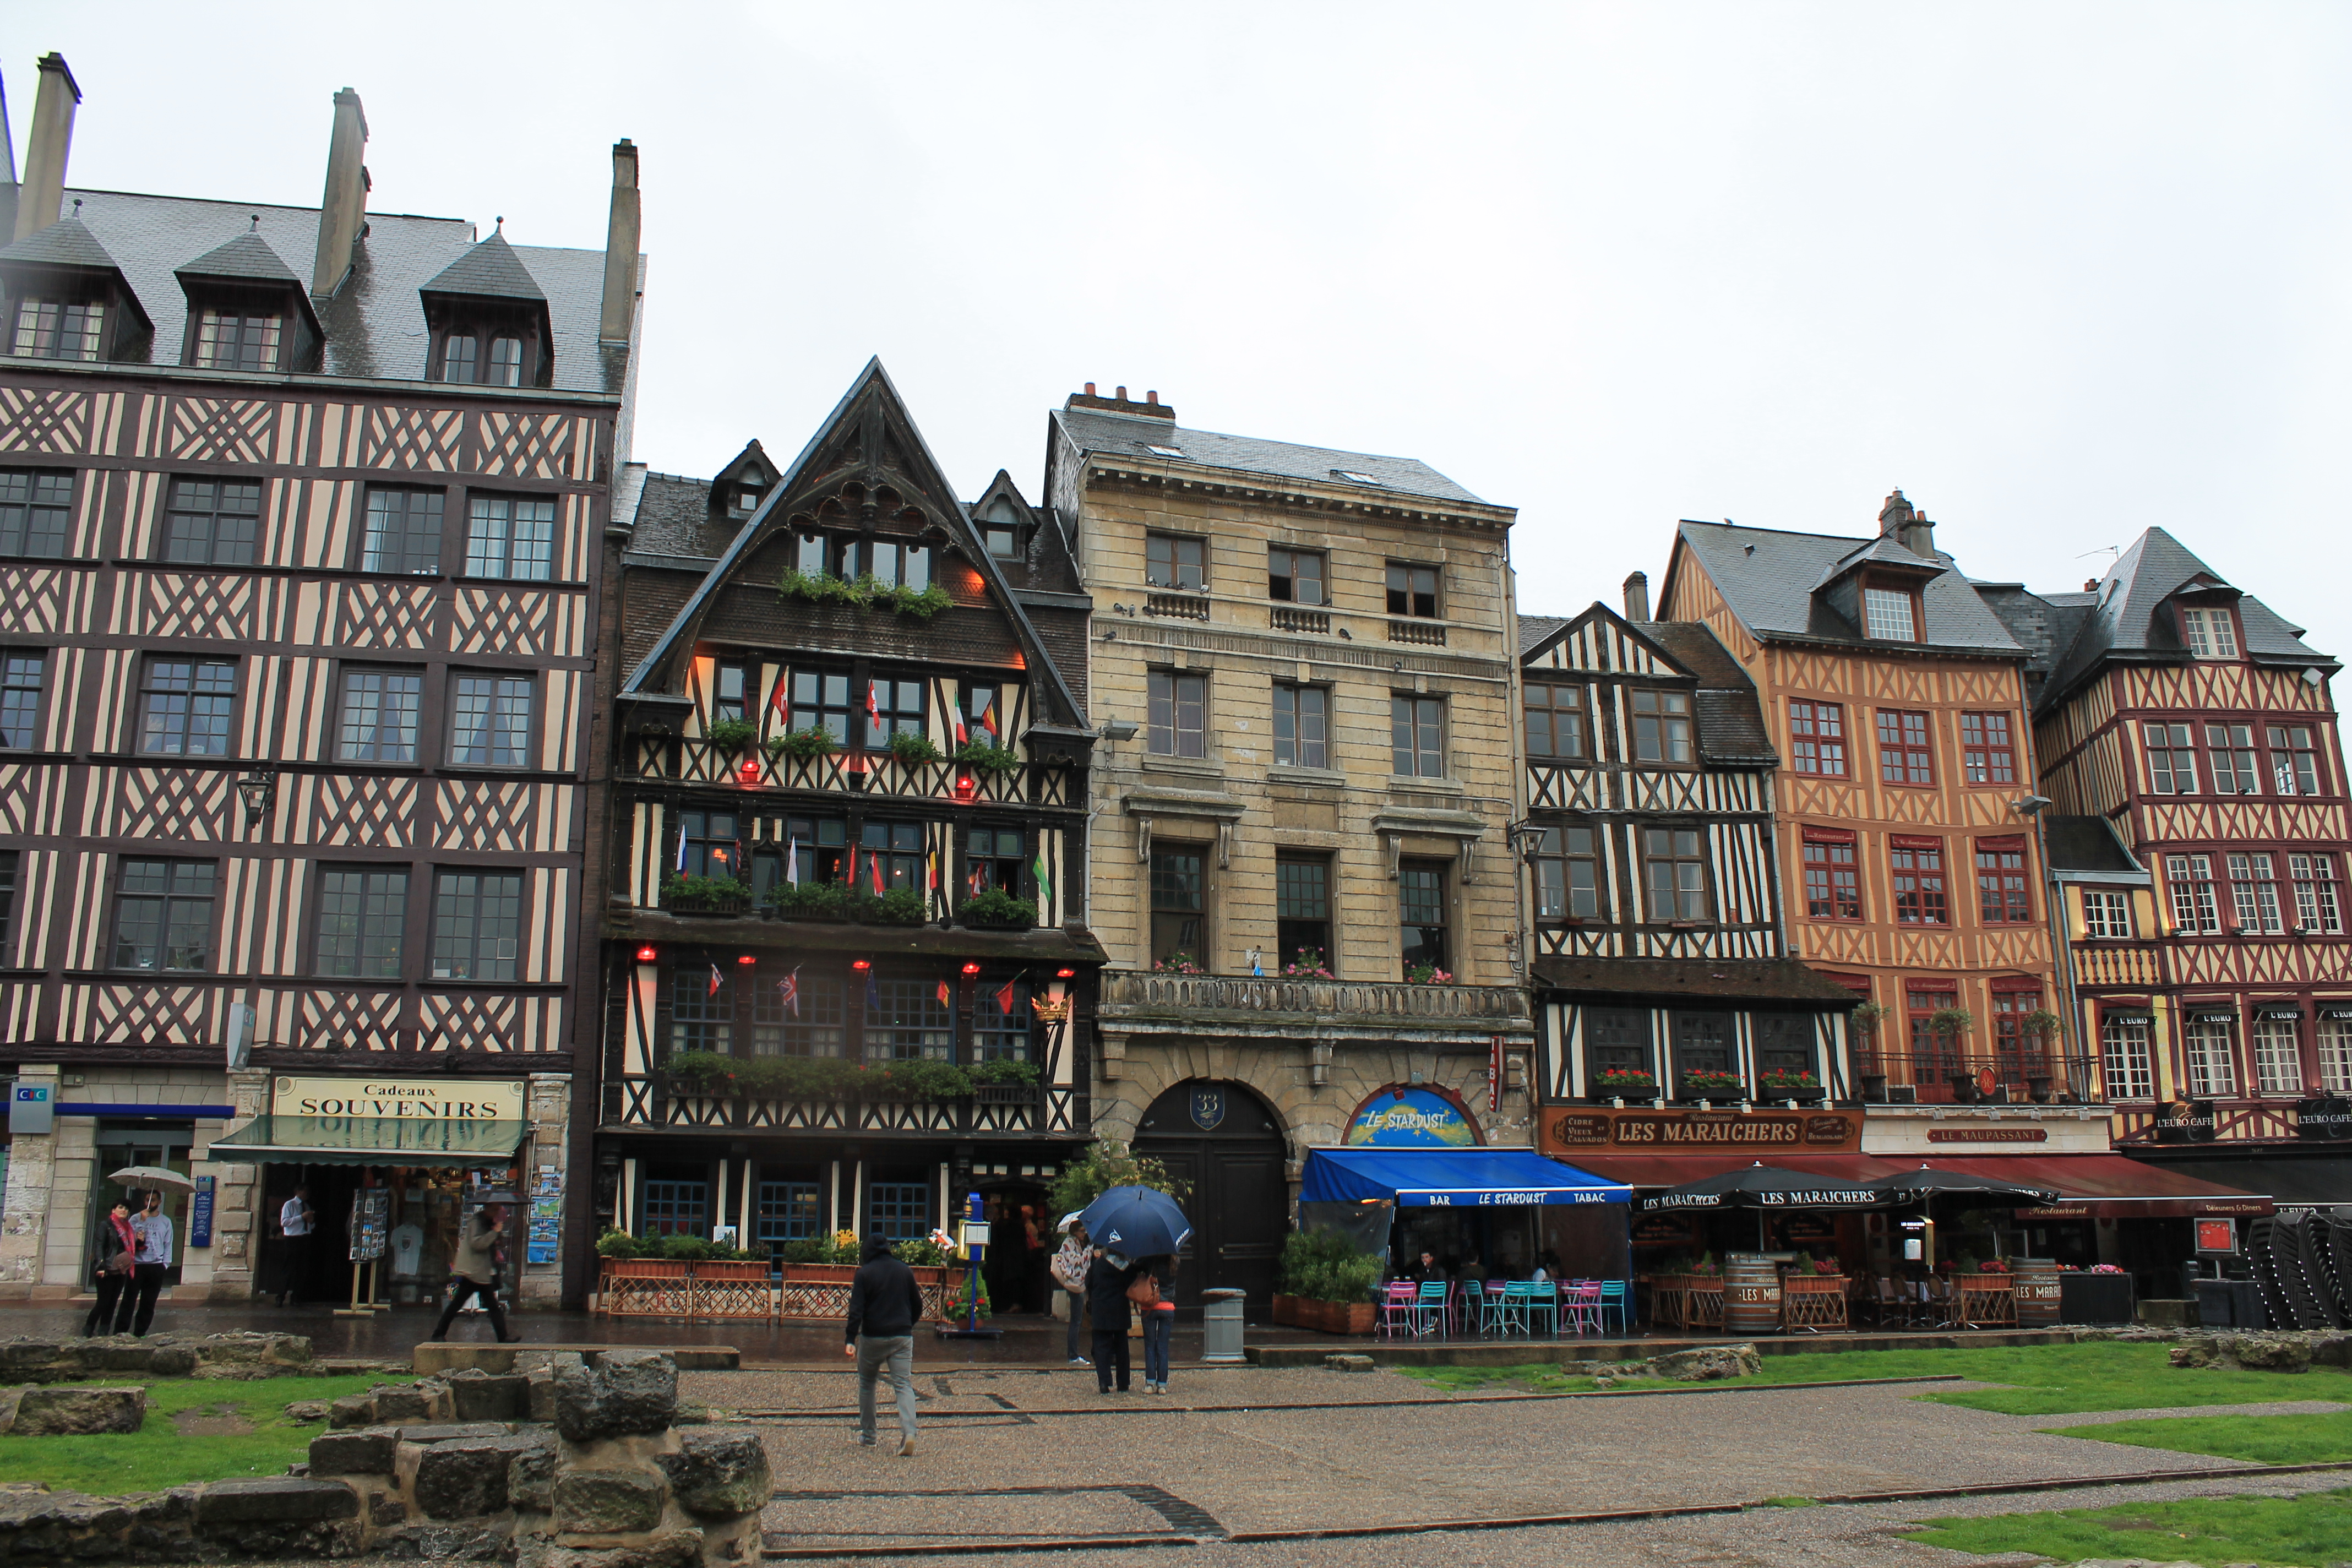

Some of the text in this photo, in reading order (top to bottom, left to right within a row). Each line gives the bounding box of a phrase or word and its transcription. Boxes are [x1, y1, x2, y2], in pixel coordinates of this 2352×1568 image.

[19, 1090, 44, 1099] CIC
[364, 1084, 437, 1096] Cadeaux
[300, 1098, 498, 1118] SOUVENIRS
[1197, 1094, 1218, 1111] 33
[1365, 1110, 1446, 1130] LE STARDUST
[1568, 1117, 1593, 1125] CIDRE
[1689, 1113, 1734, 1121] Restaurant
[2157, 1118, 2189, 1128] L'EURO
[2299, 1115, 2329, 1124] L'EURO
[1619, 1123, 1798, 1141] LES MARAICHERS
[1941, 1131, 2036, 1140] LE MAUPASSANT
[1430, 1193, 1605, 1205] BAR LE STARDUST TABAC
[1643, 1194, 1721, 1210] LES MARAICHERS
[1761, 1190, 1905, 1205] LES MARAICHERS 37
[2029, 1206, 2087, 1215] Restaurant
[1742, 1288, 1758, 1301] LES
[2016, 1286, 2030, 1298] LES
